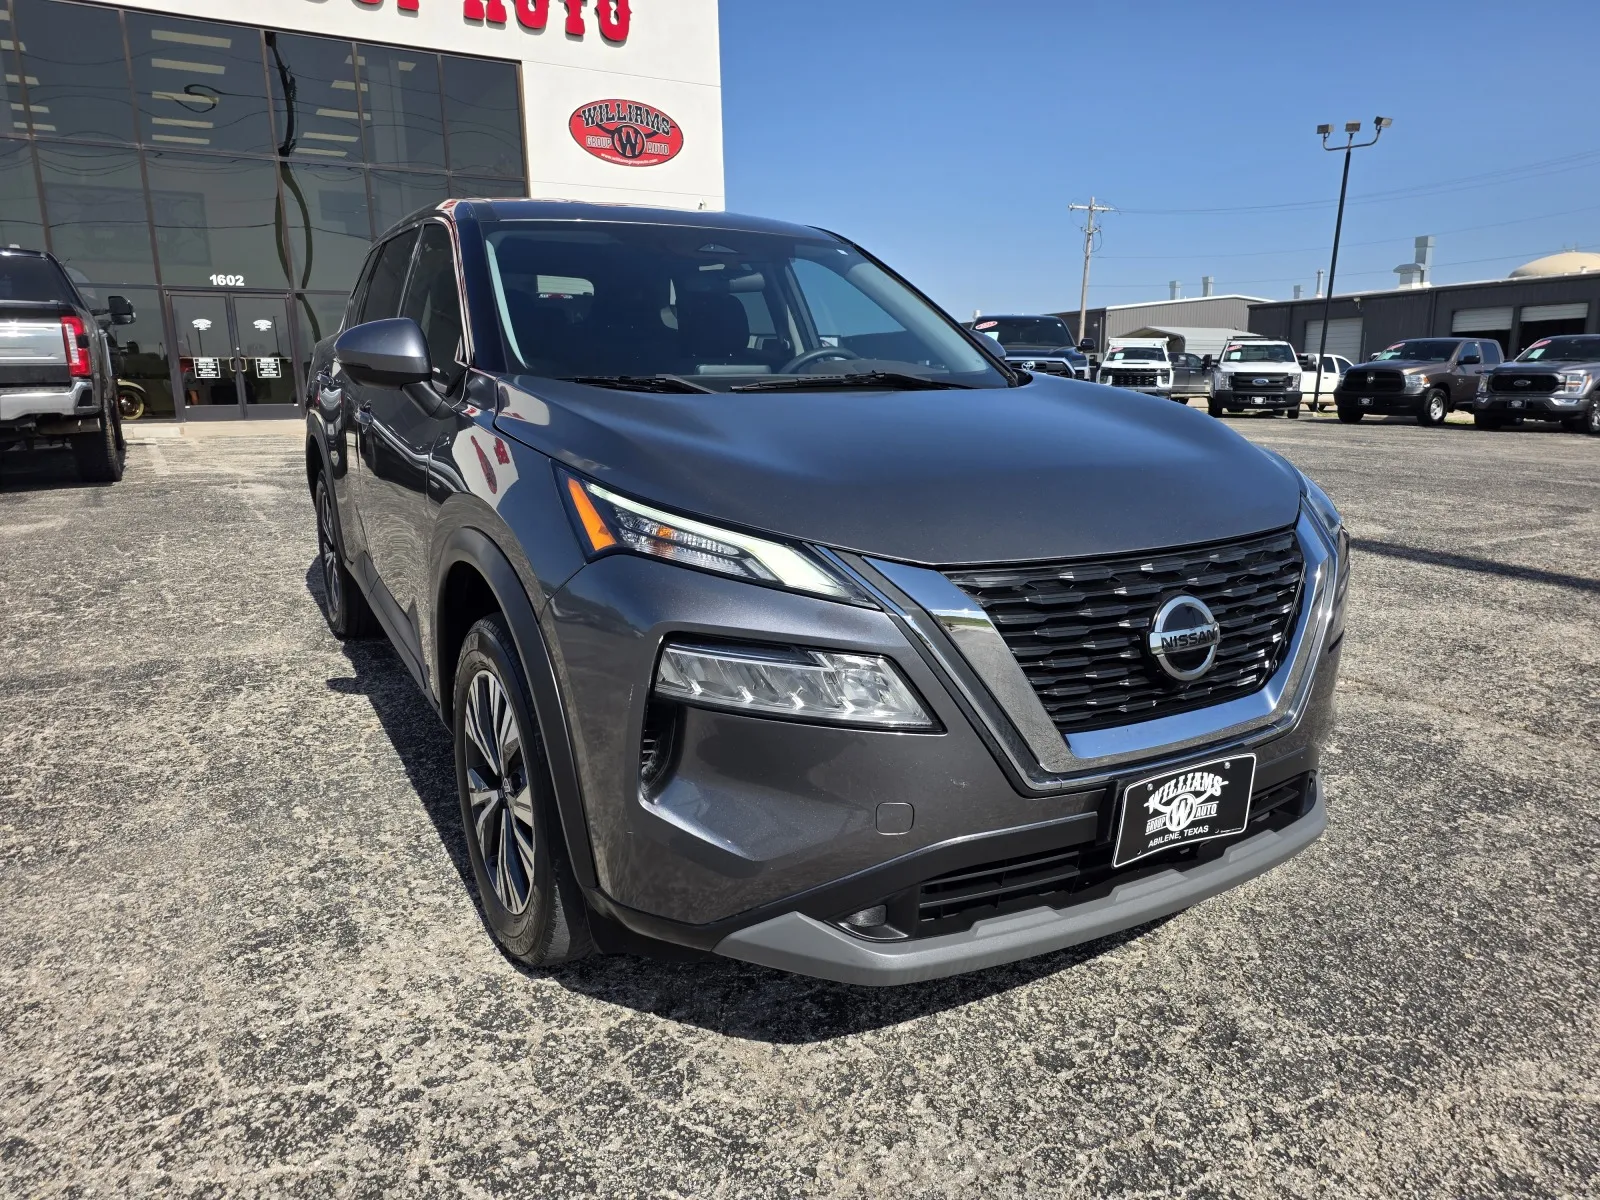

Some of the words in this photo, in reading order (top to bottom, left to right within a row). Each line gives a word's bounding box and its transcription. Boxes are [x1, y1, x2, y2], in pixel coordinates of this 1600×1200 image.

[581, 103, 671, 137] WILLIAMS
[586, 135, 612, 148] GROUP
[647, 142, 670, 155] AUTO
[209, 274, 245, 287] 1602
[1161, 629, 1217, 649] NISSAN
[1147, 772, 1223, 814] WILLIAMS
[1145, 816, 1167, 833] GROUP
[1195, 803, 1218, 818] AUTO
[1148, 832, 1182, 848] ABILENE,
[1184, 825, 1209, 837] TEXAS
